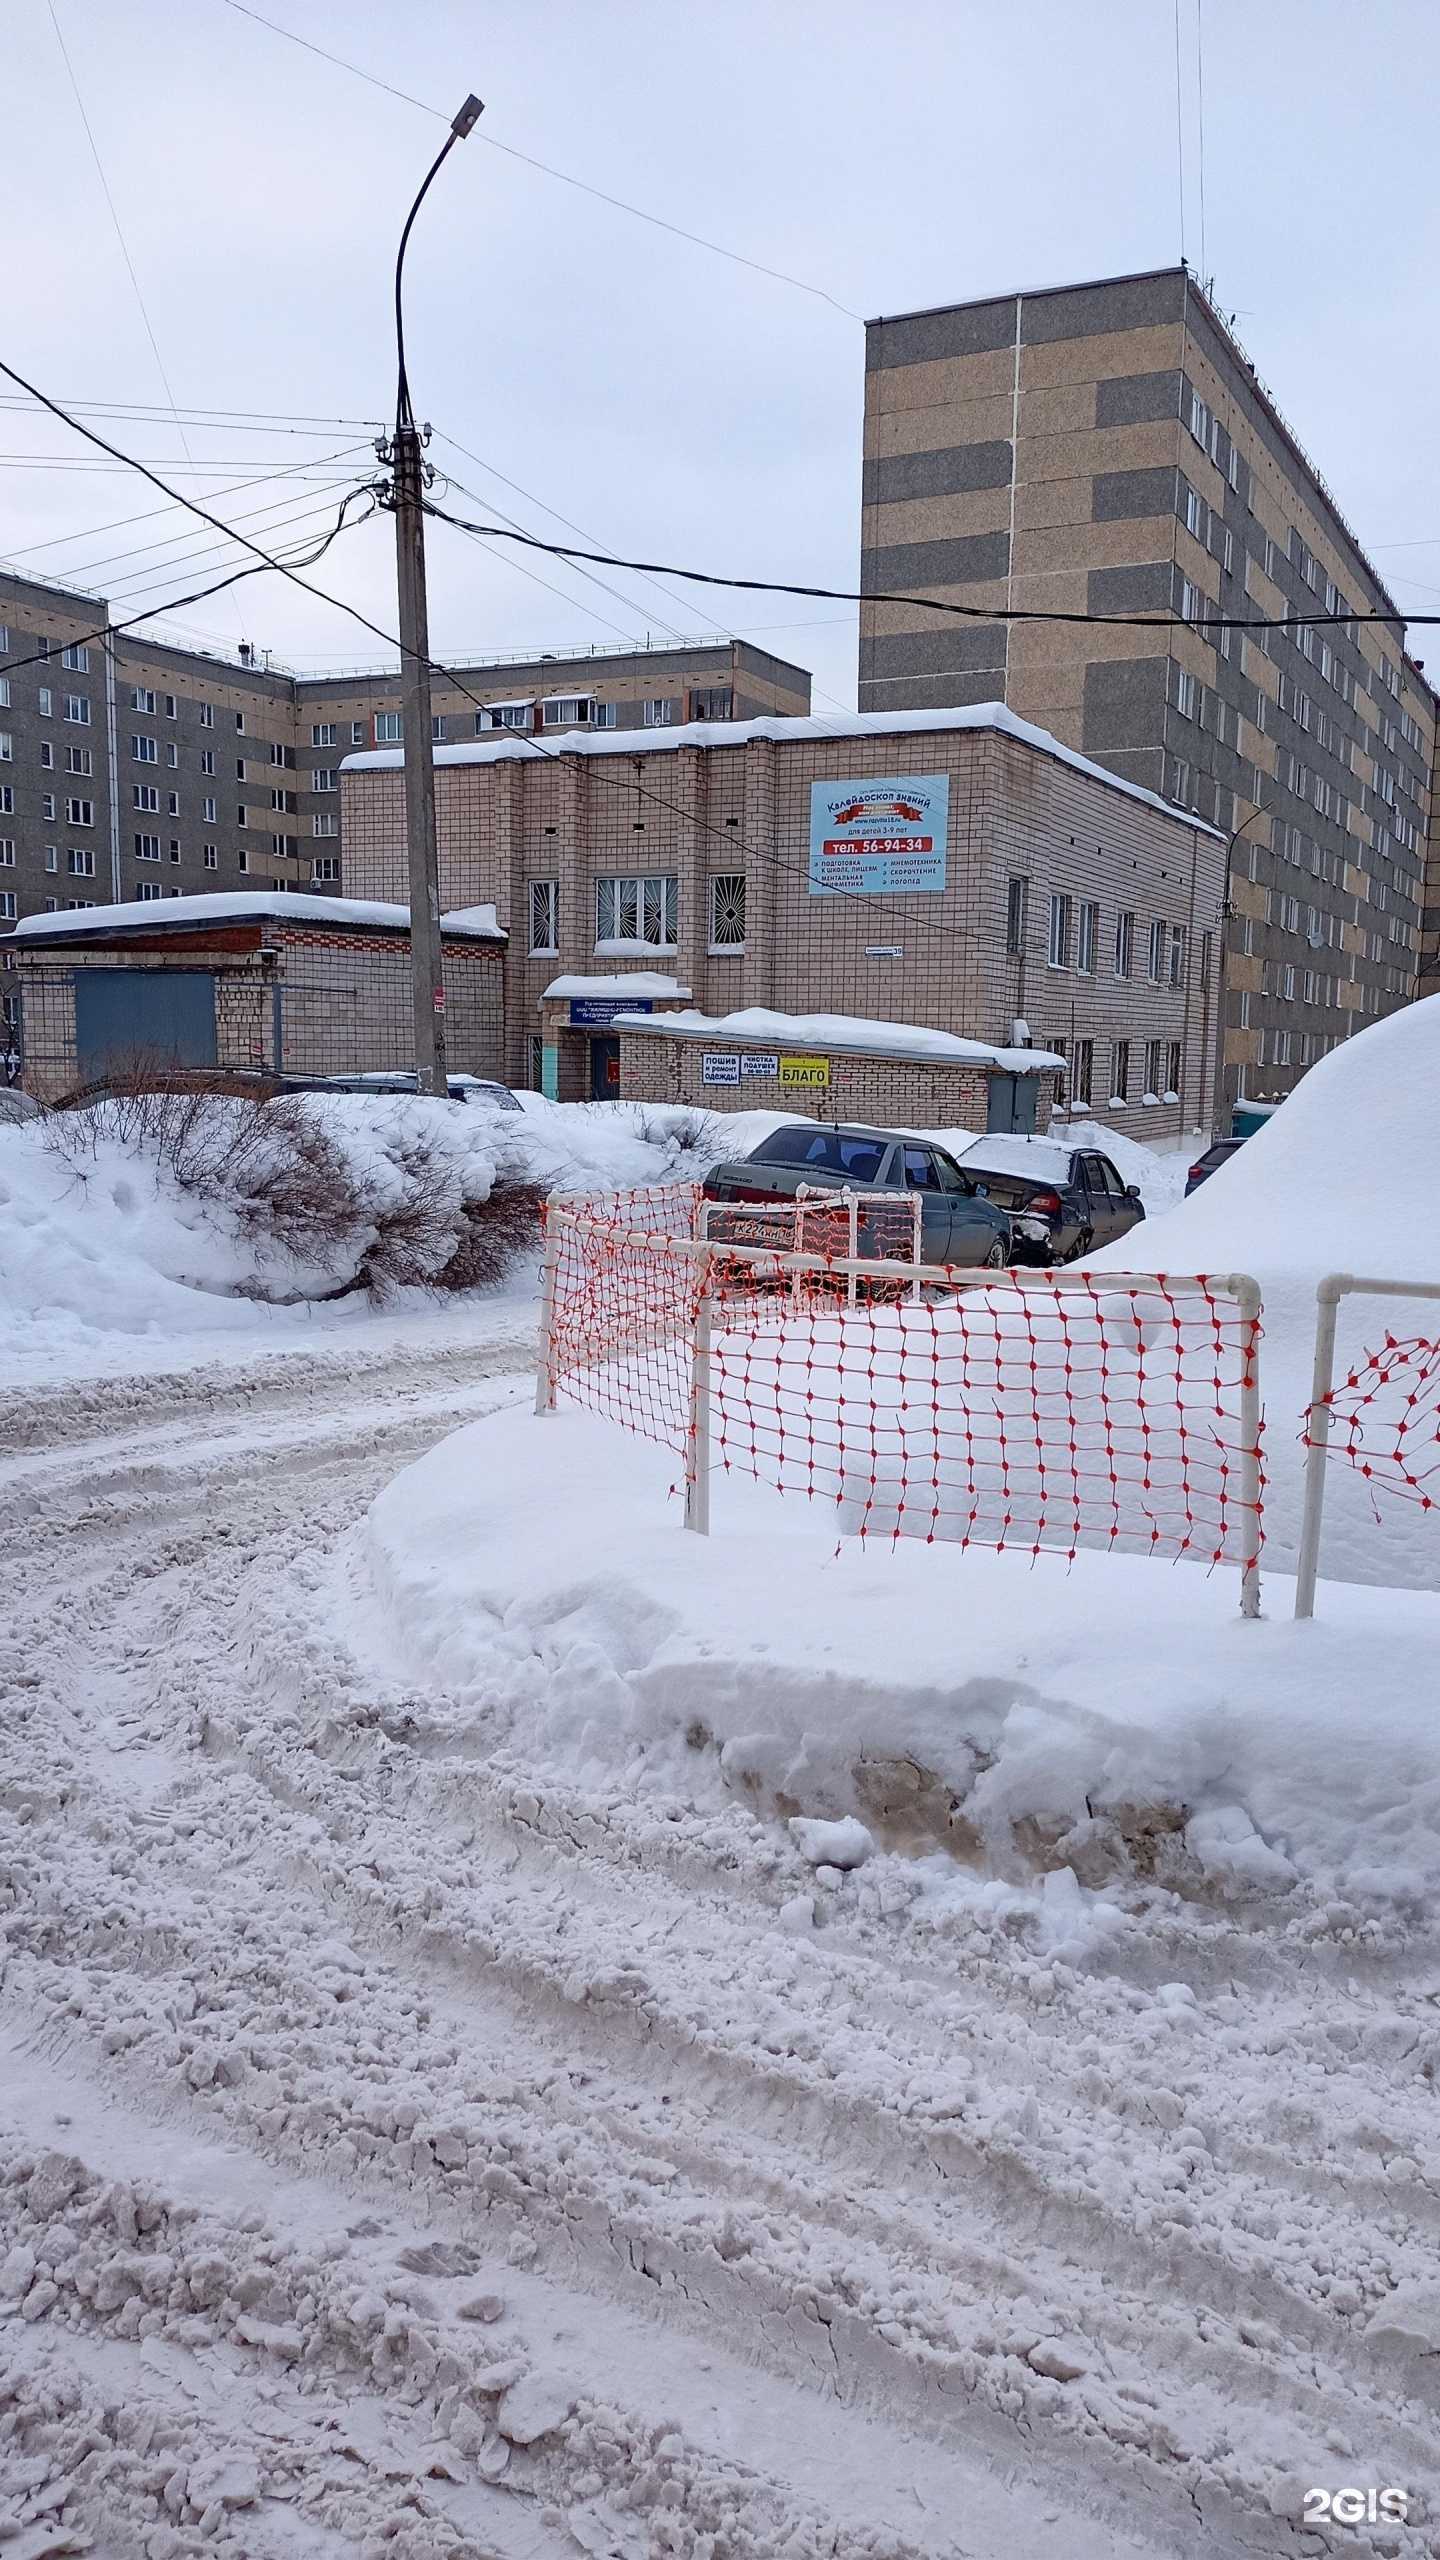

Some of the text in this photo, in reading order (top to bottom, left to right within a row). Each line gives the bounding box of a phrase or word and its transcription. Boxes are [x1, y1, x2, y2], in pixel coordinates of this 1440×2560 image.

[827, 792, 894, 813] Калейдоскоп
[896, 792, 931, 809] знаний
[848, 828, 860, 836] для
[862, 827, 881, 835] детей
[883, 826, 895, 834] 3-9
[833, 839, 923, 853] тел. 56-94-34
[890, 868, 936, 876] СКОРОЧТЕНИЕ
[705, 1057, 737, 1065] ПОШИВ
[782, 1069, 825, 1082] БЛАГО
